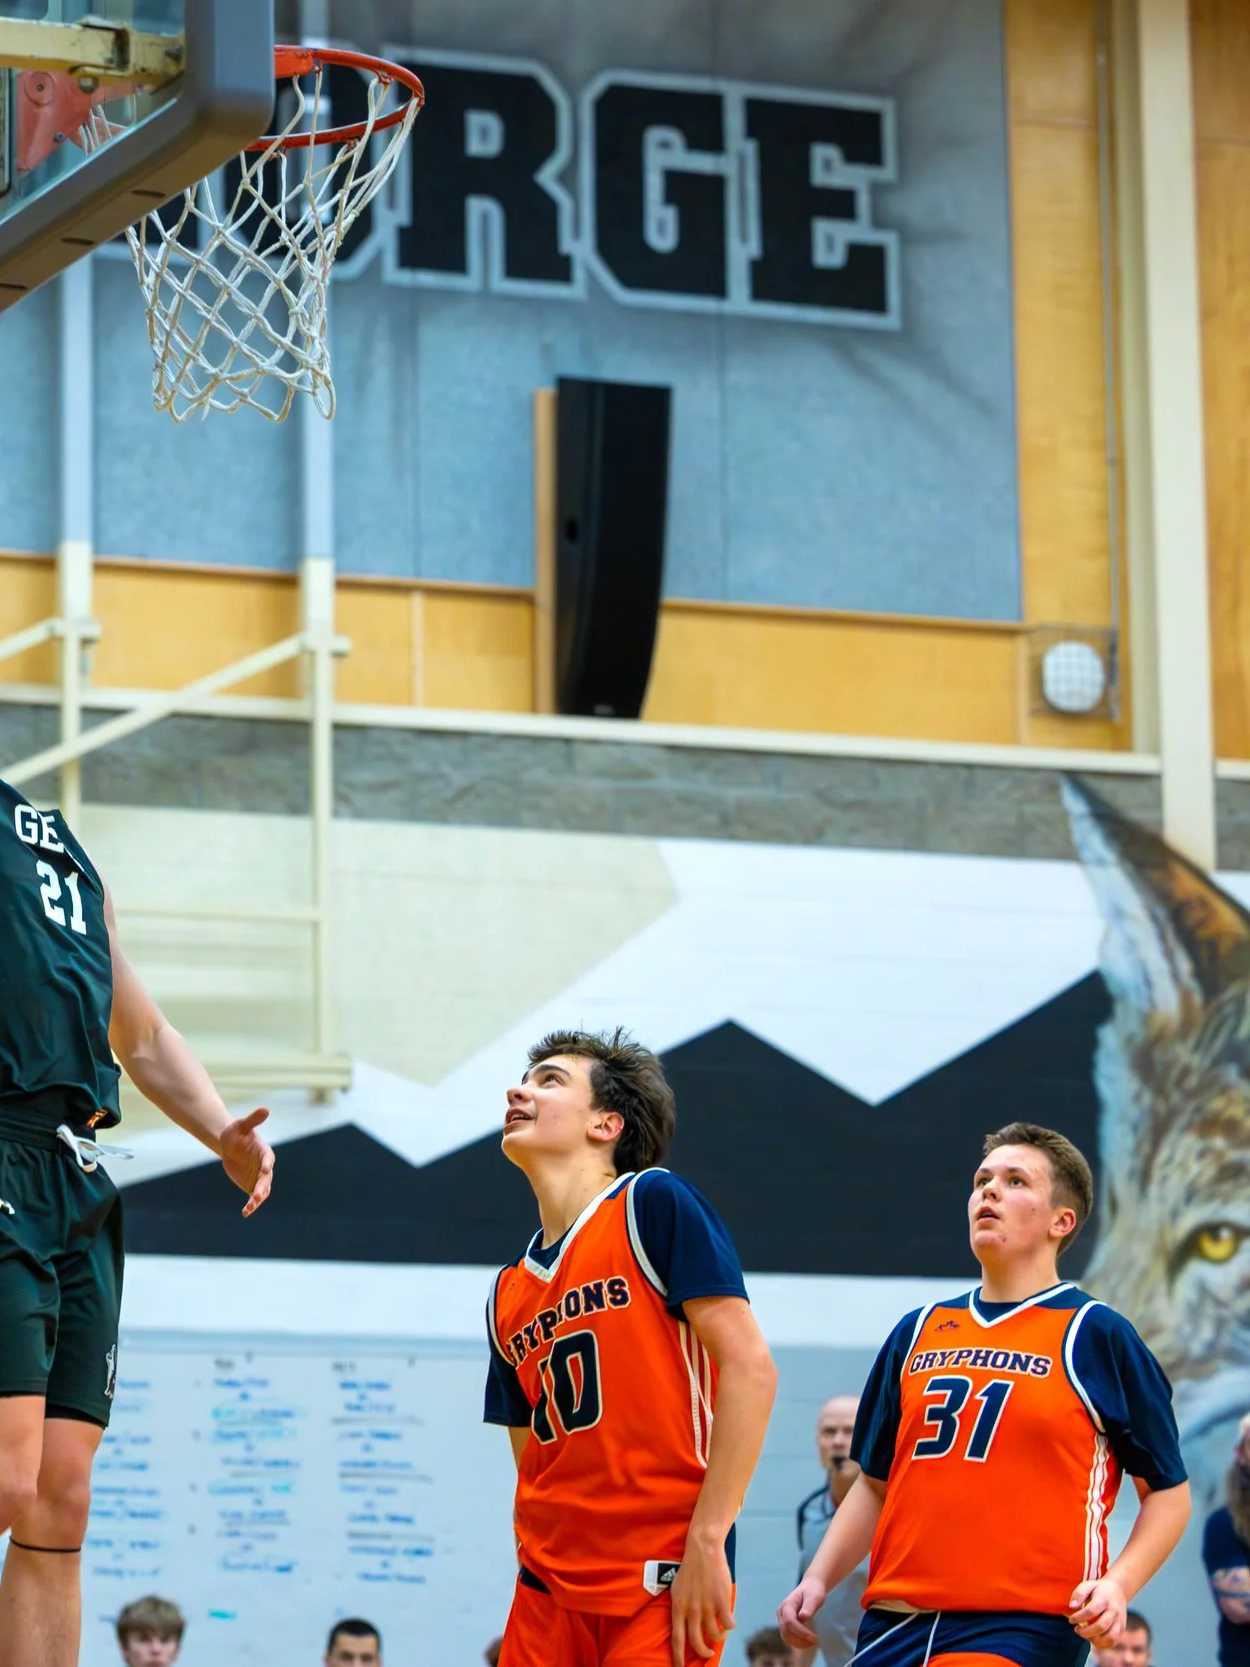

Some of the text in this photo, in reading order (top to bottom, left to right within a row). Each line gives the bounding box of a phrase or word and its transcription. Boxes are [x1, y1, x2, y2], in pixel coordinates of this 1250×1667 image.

[135, 42, 902, 330] ORGE
[36, 858, 87, 935] 21
[508, 1275, 631, 1370] RYPONS
[908, 1347, 1053, 1379] GRYPHONS
[531, 1328, 603, 1445] 10
[910, 1374, 1015, 1464] 31
